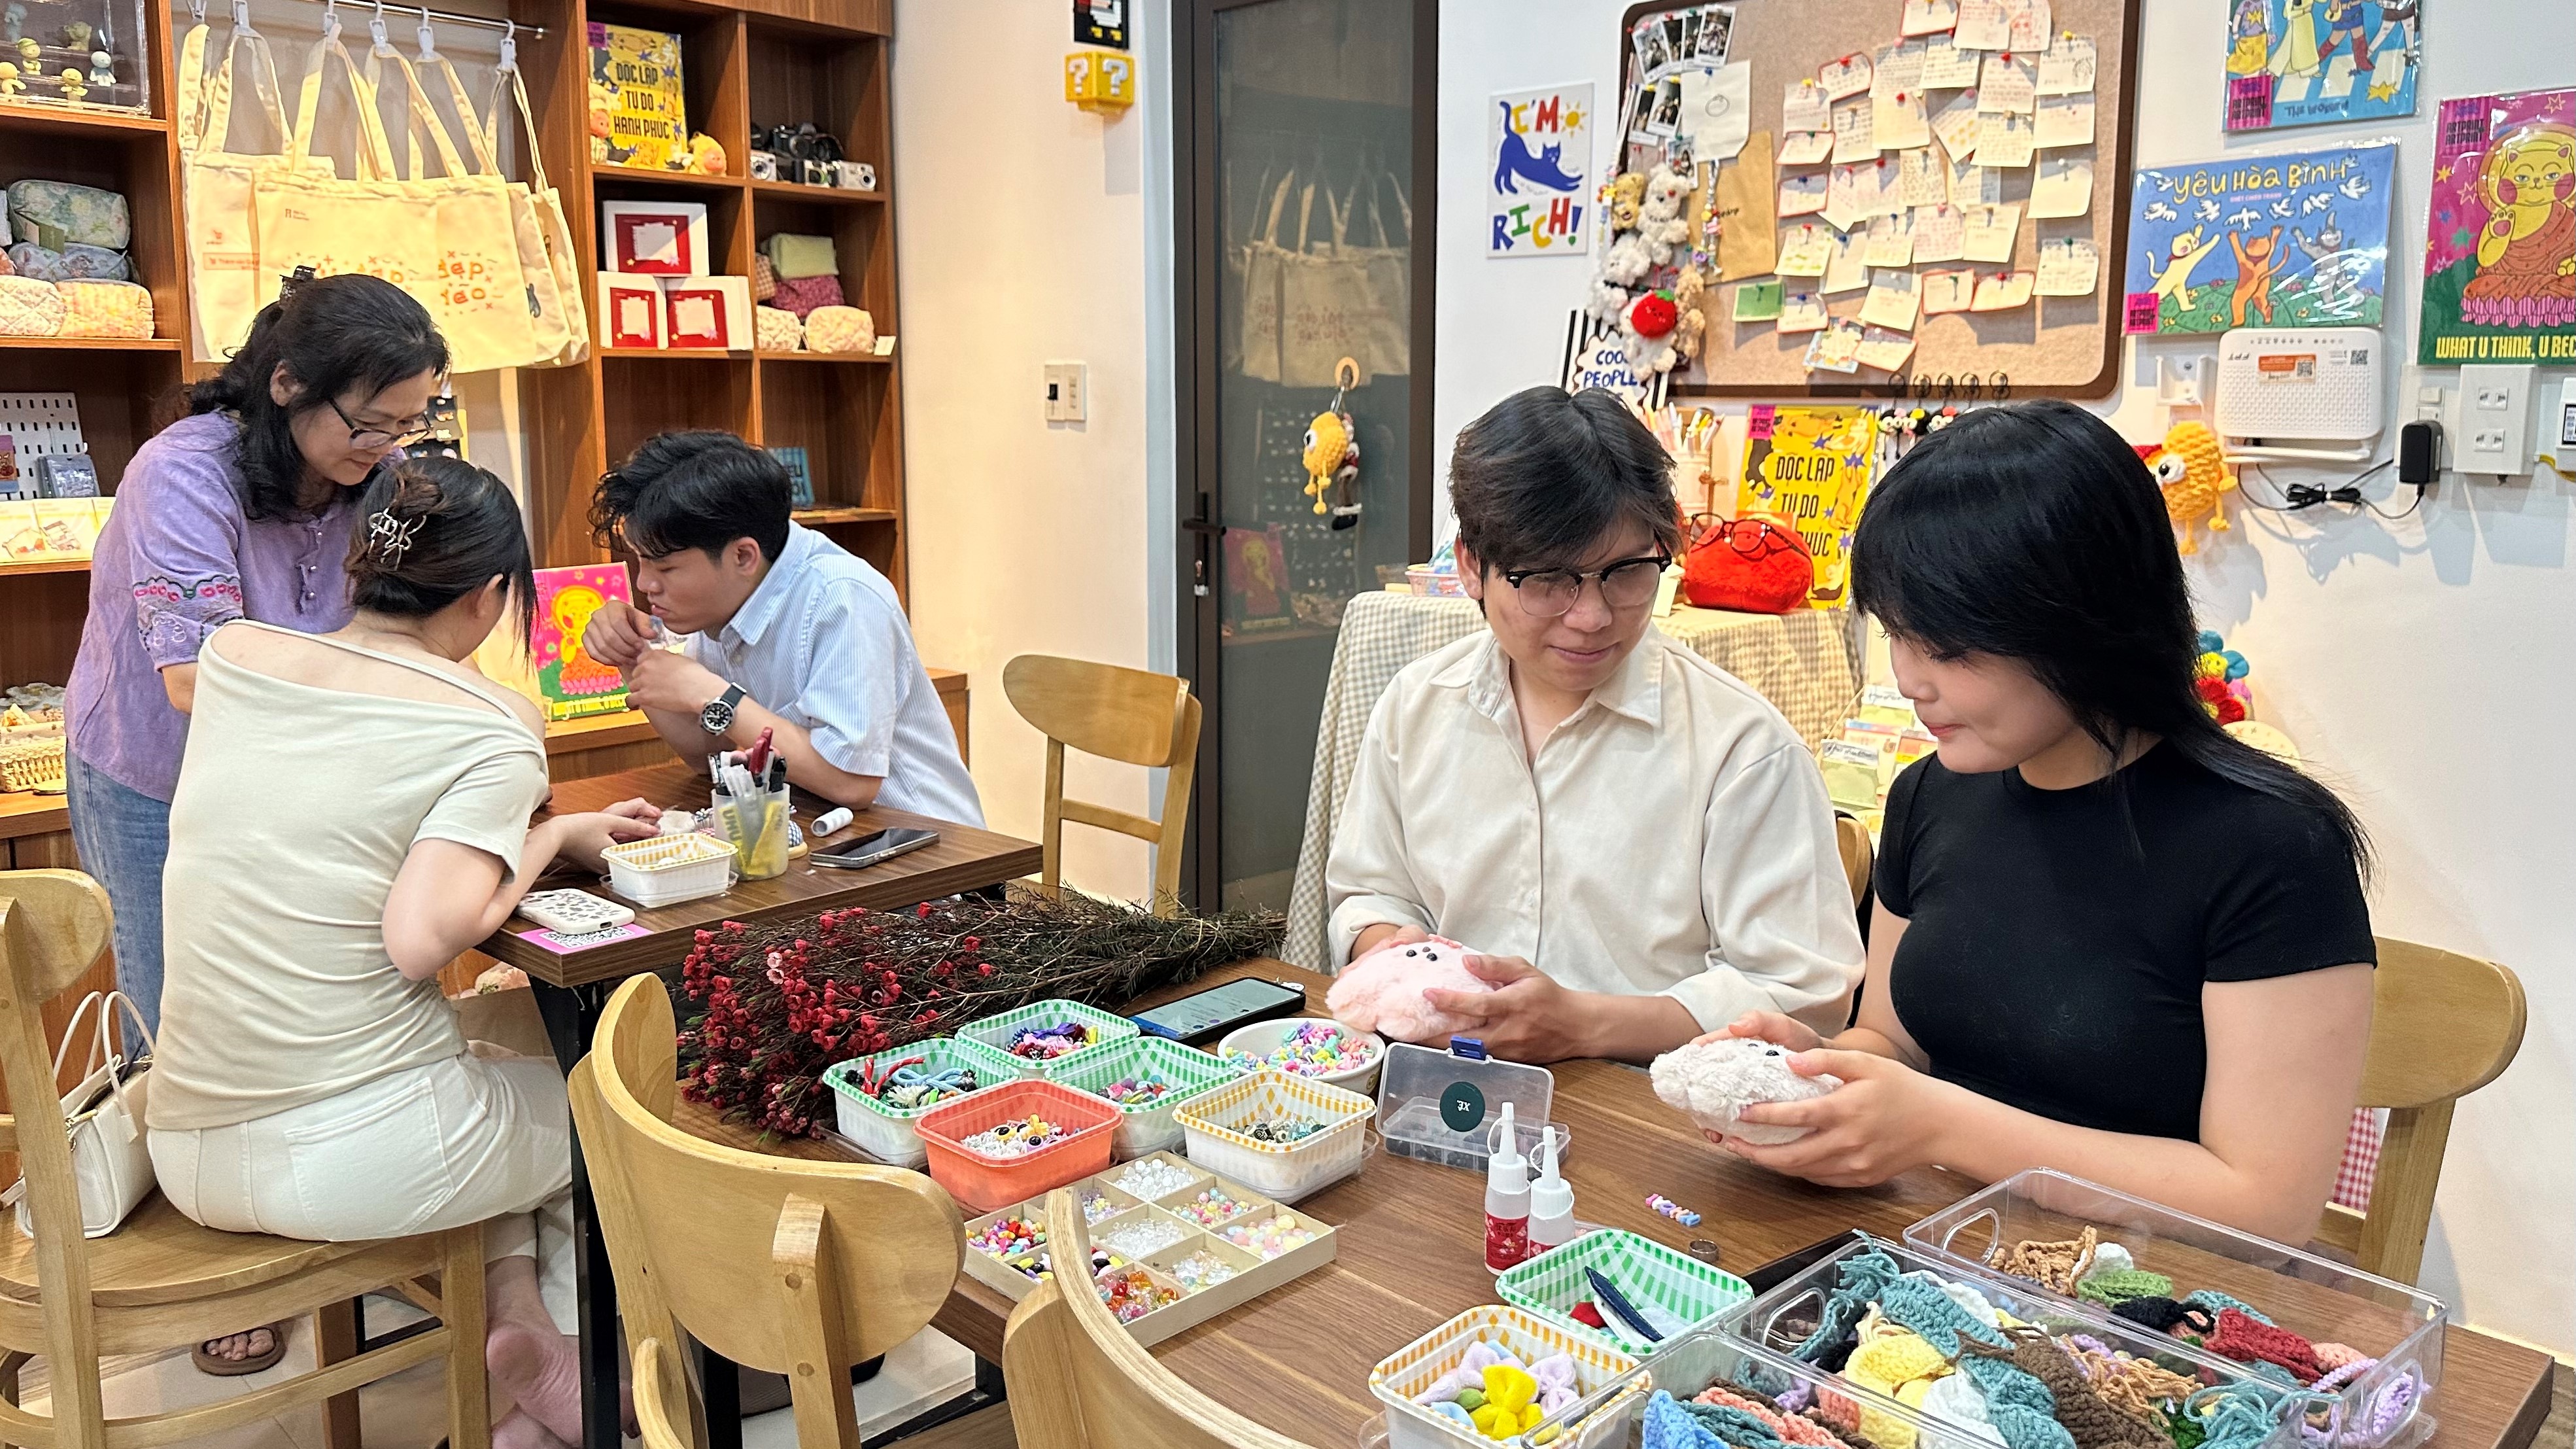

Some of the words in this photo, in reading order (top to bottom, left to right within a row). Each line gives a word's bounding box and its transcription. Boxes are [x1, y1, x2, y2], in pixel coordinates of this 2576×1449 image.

[641, 92, 654, 111] DO
[1511, 95, 1560, 134] I'M
[1493, 198, 1583, 251] RICH!
[1596, 350, 1629, 365] COO
[2435, 336, 2477, 358] WHAT
[2477, 336, 2488, 358] U
[2538, 335, 2549, 358] U
[1799, 494, 1819, 518] DO
